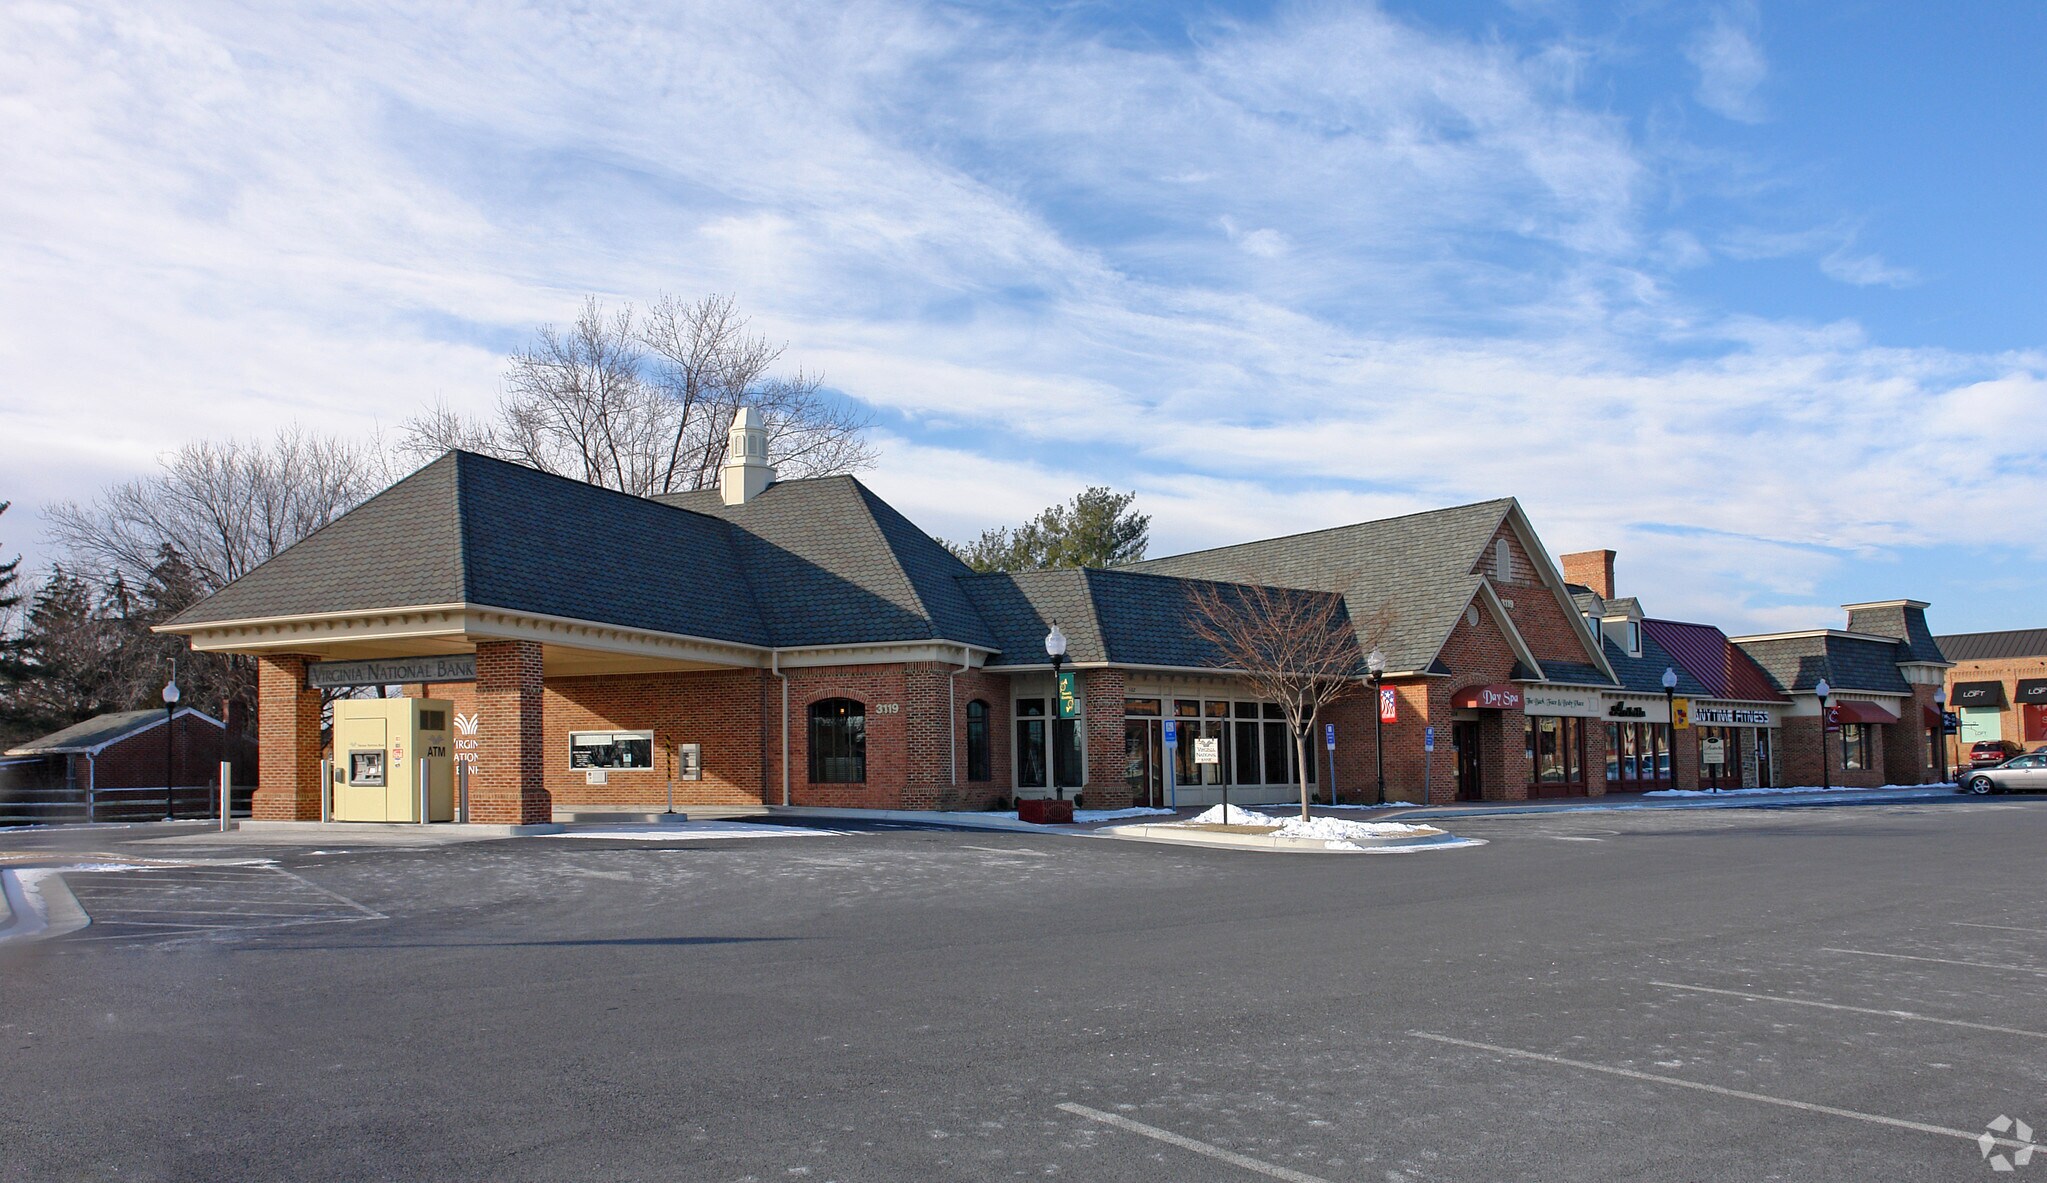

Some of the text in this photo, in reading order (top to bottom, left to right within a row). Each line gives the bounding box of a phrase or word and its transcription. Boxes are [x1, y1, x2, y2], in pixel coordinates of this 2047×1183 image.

[312, 660, 474, 683] VIRGINIA NATIONAL BANK
[1483, 690, 1519, 706] Day Spa
[1963, 689, 1986, 698] LOFT
[875, 703, 899, 714] 3119
[1695, 709, 1770, 723] ANYTIME FITNESS
[427, 746, 446, 757] ATM
